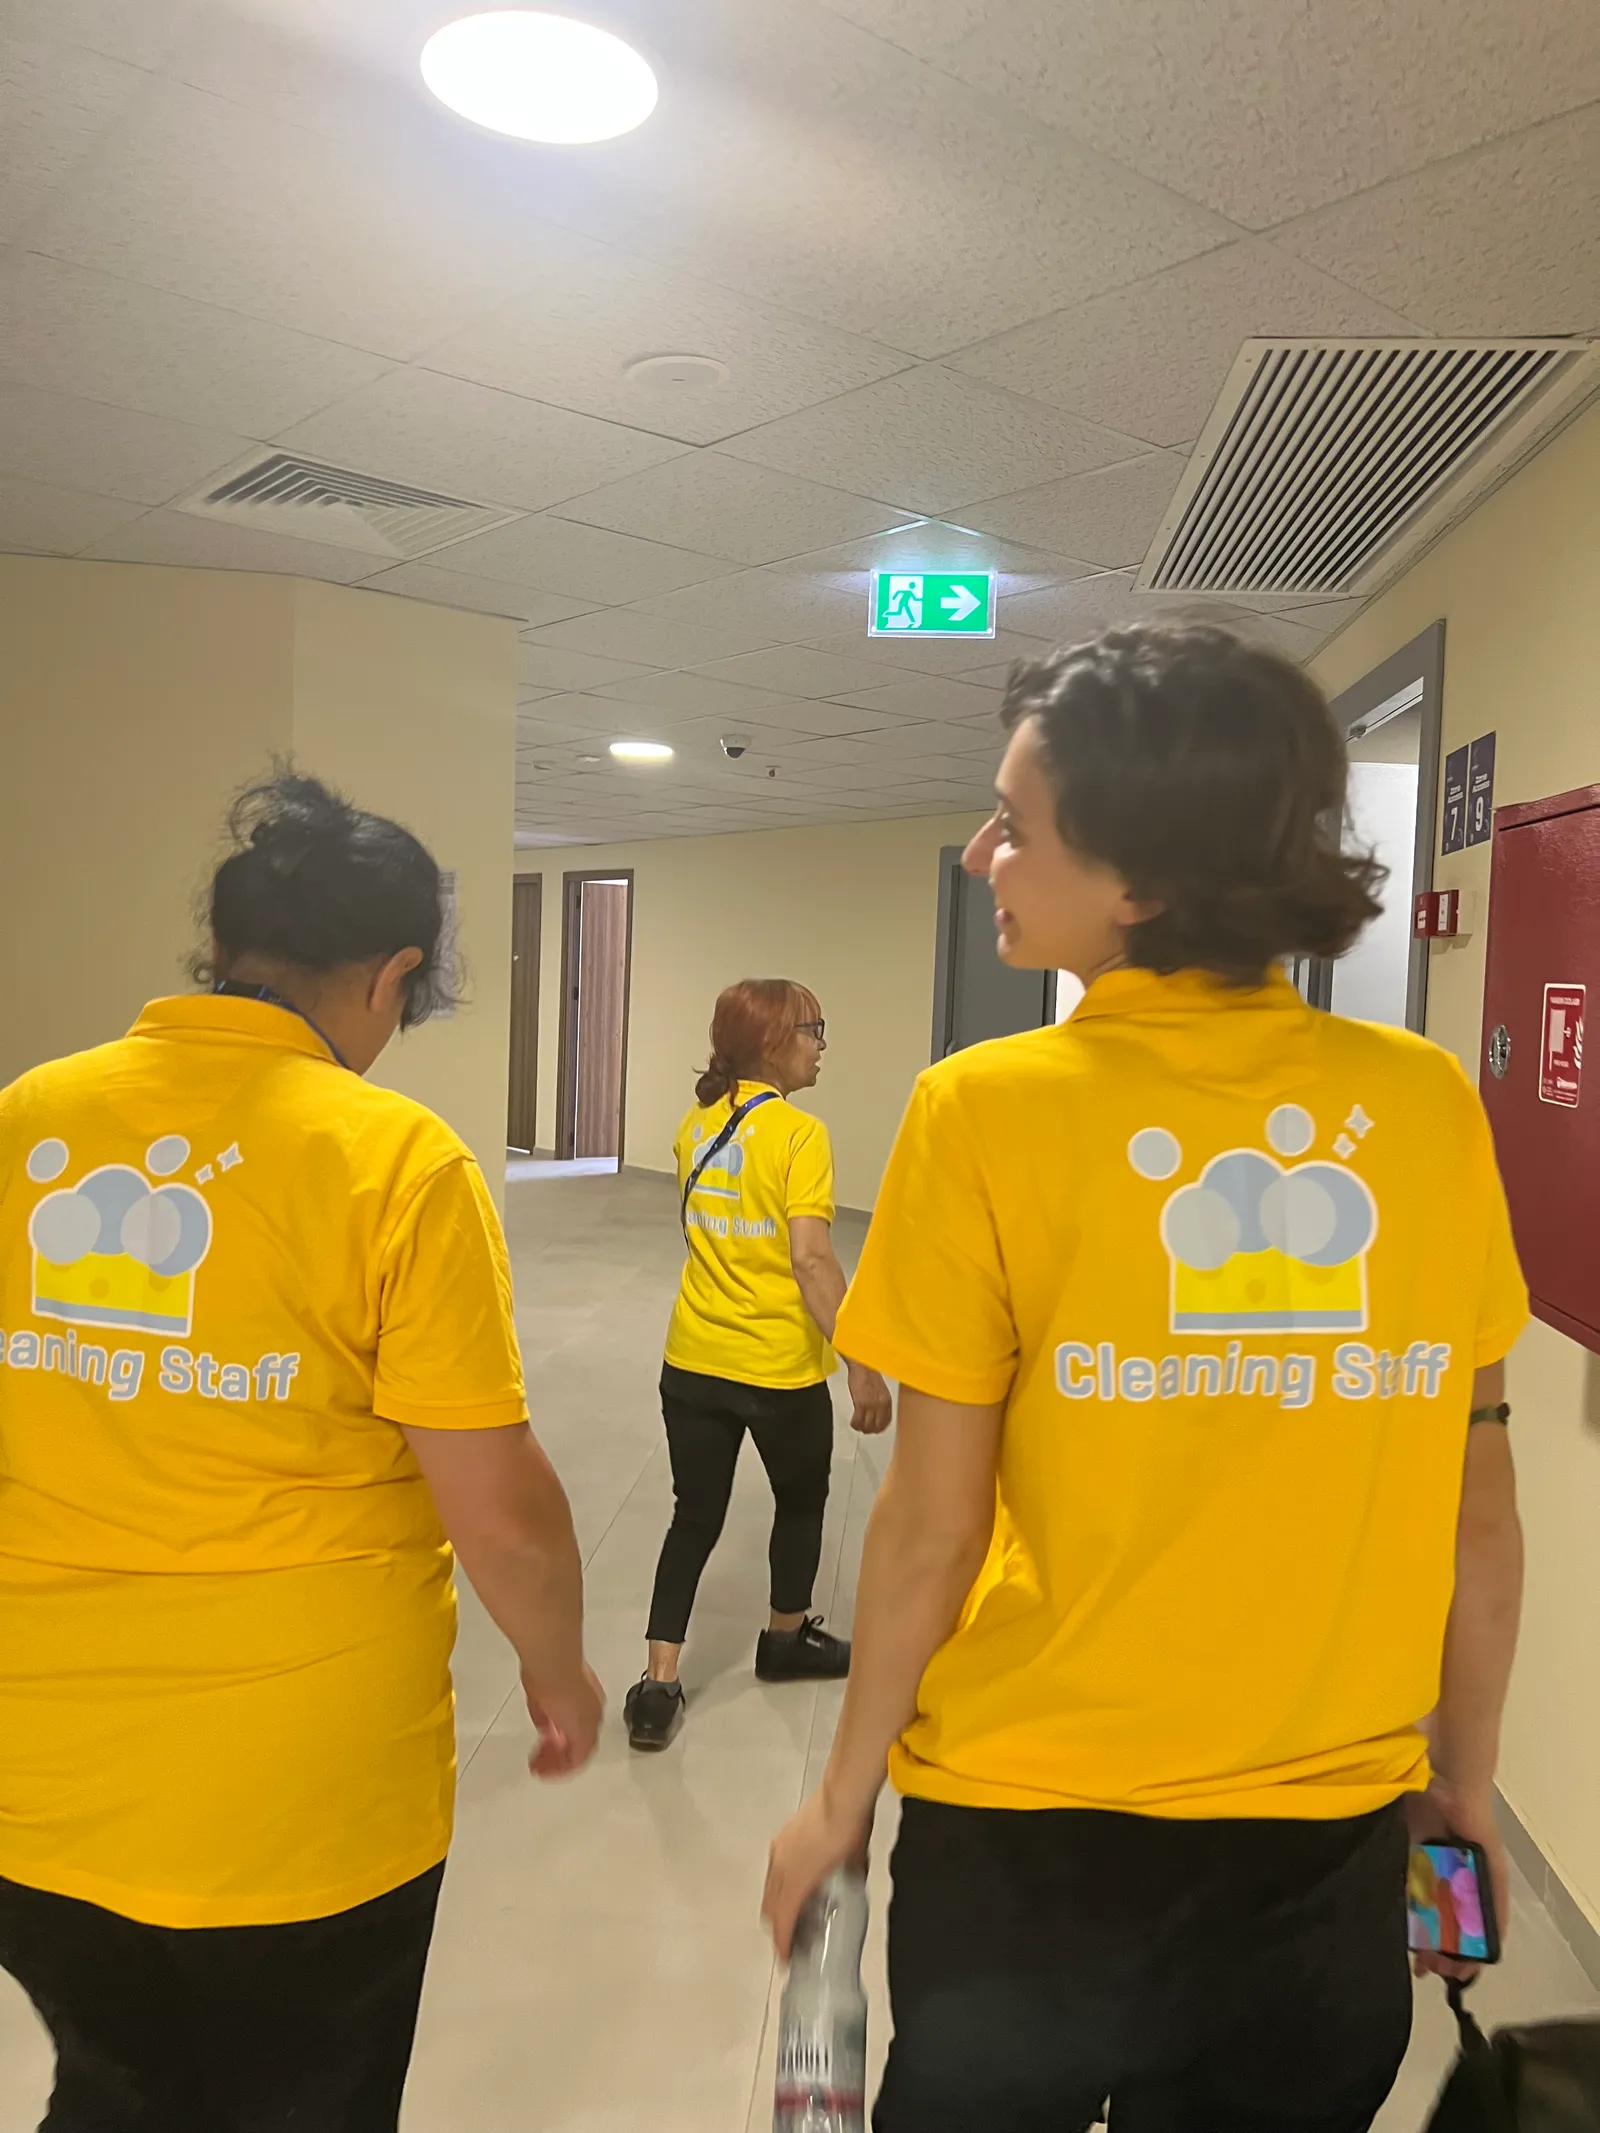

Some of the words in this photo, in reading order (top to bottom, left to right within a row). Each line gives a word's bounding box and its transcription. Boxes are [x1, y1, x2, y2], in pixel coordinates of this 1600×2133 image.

[1450, 806, 1458, 841] 7
[1475, 796, 1484, 832] 9
[0, 1329, 145, 1401] aning
[159, 1345, 300, 1401] Staff
[1054, 1341, 1315, 1409] Cleaning
